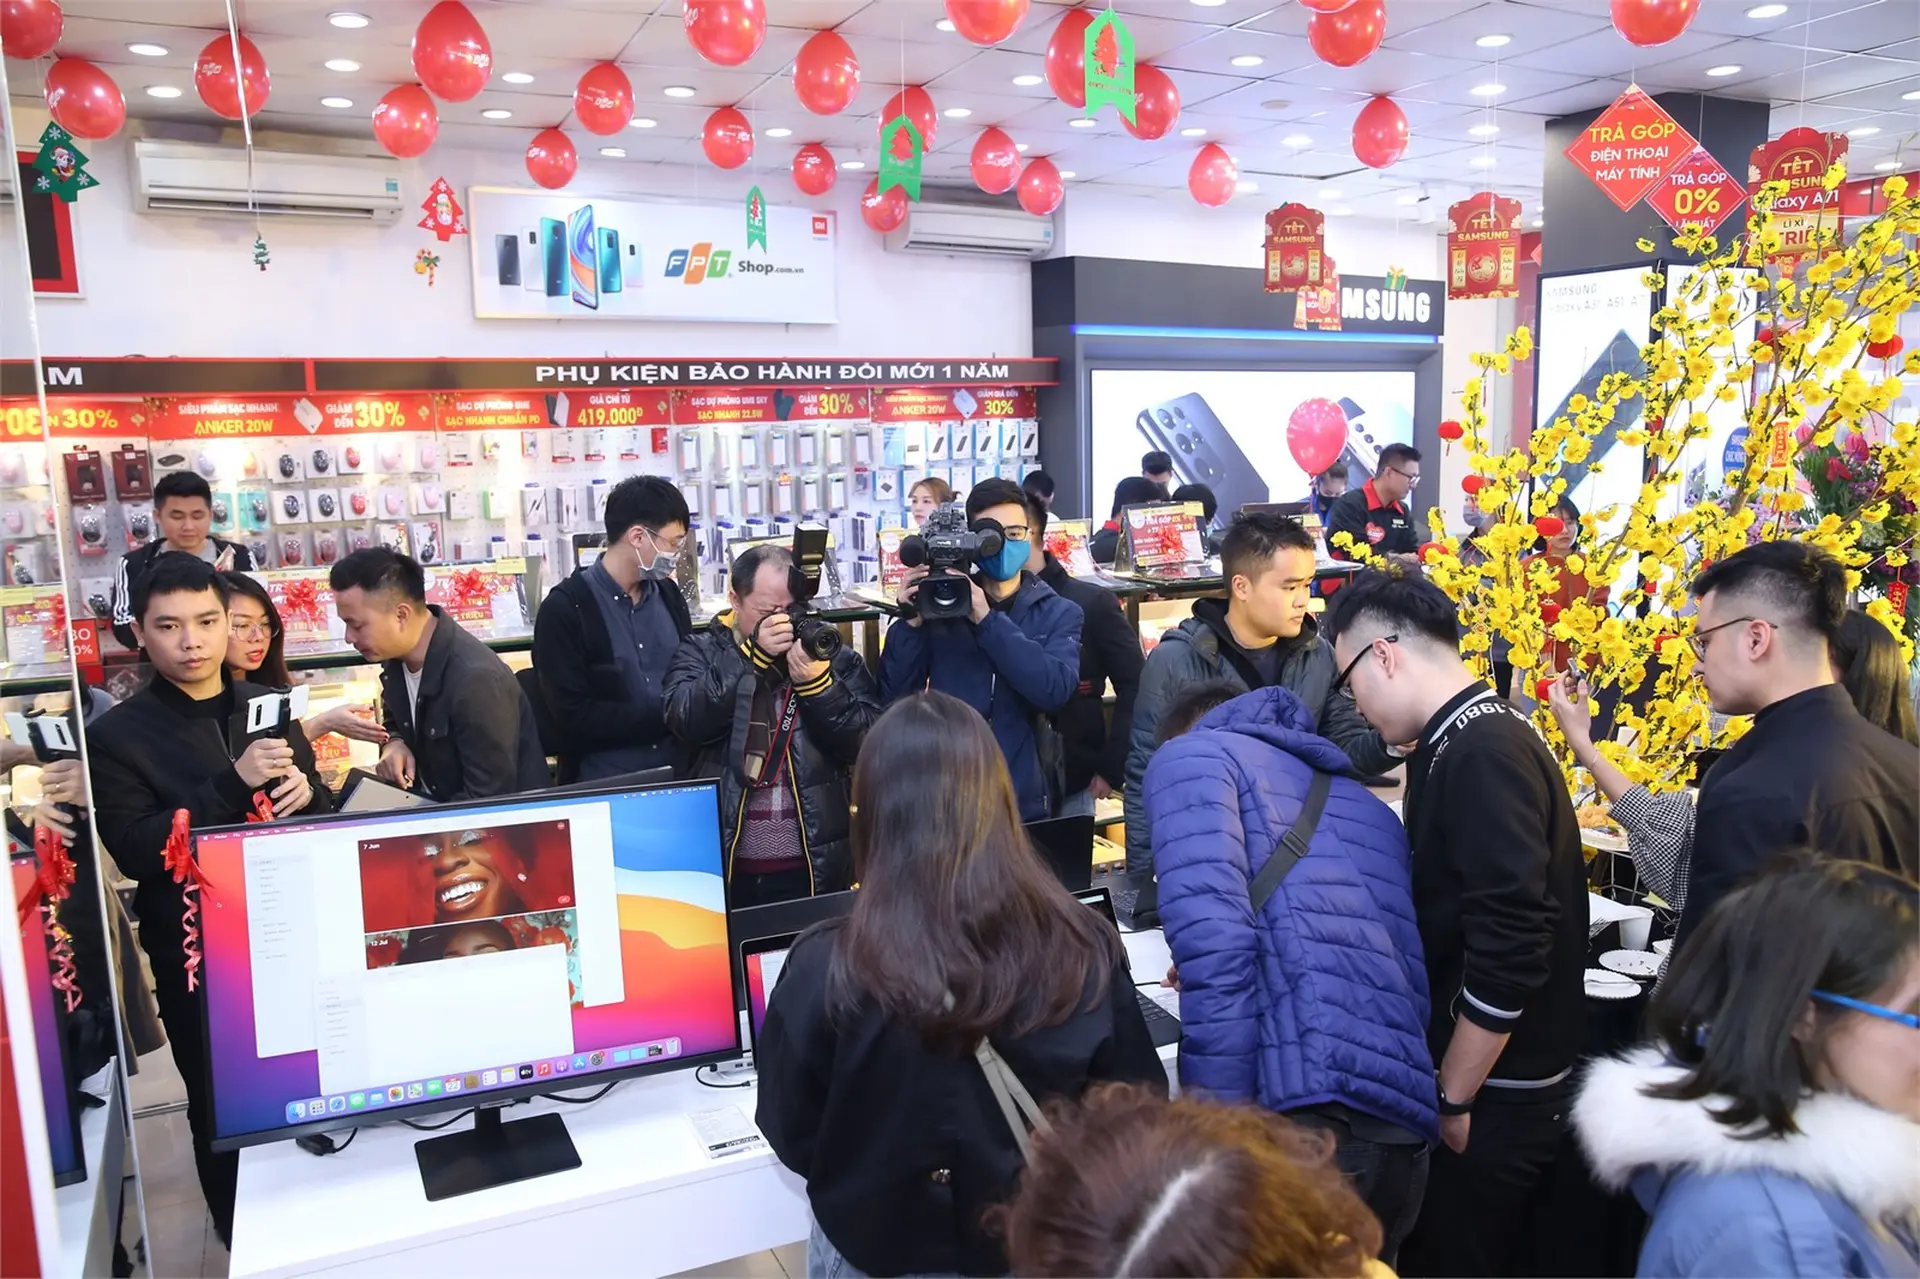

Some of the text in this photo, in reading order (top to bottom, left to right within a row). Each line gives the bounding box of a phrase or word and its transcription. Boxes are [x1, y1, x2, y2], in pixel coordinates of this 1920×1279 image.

[1589, 119, 1676, 143] TRẢ GÓP
[1590, 146, 1668, 164] ĐIỆN THOẠI
[1596, 165, 1660, 181] MÁY TÍNH
[1781, 155, 1814, 176] TẾT
[1670, 170, 1727, 185] TRẢ GÓP
[1674, 187, 1721, 214] 0%
[1285, 221, 1305, 234] TẾT
[1471, 213, 1497, 229] TẾT
[1273, 235, 1316, 244] SAMSUNG
[1457, 231, 1509, 242] SAMSUNG
[665, 250, 730, 278] FPT
[1341, 286, 1431, 323] MSUNG
[535, 365, 600, 385] PHỤ
[610, 363, 679, 384] KIỆN
[688, 362, 750, 381] BẢO
[758, 361, 831, 380] HÀNH
[890, 362, 935, 380] MỚI
[941, 365, 951, 379] 1
[960, 362, 1009, 379] NĂM
[456, 401, 472, 412] SẠC
[589, 394, 603, 405] GIÁ
[691, 397, 705, 406] SẠC
[798, 394, 818, 404] GIẢM
[818, 393, 854, 415] 30%
[326, 402, 353, 414] GIẢM
[355, 400, 405, 428] 30%
[697, 409, 763, 421] SẠC NHANH 22.5W
[891, 404, 946, 416] ANKER 20W
[984, 400, 1013, 415] 30%
[62, 409, 118, 429] 30%
[195, 419, 273, 435] ANKER 20W
[334, 413, 353, 428] ĐẾN
[446, 411, 540, 427] SẠC NHANH CHUẨN PD
[781, 715, 793, 731] 70D
